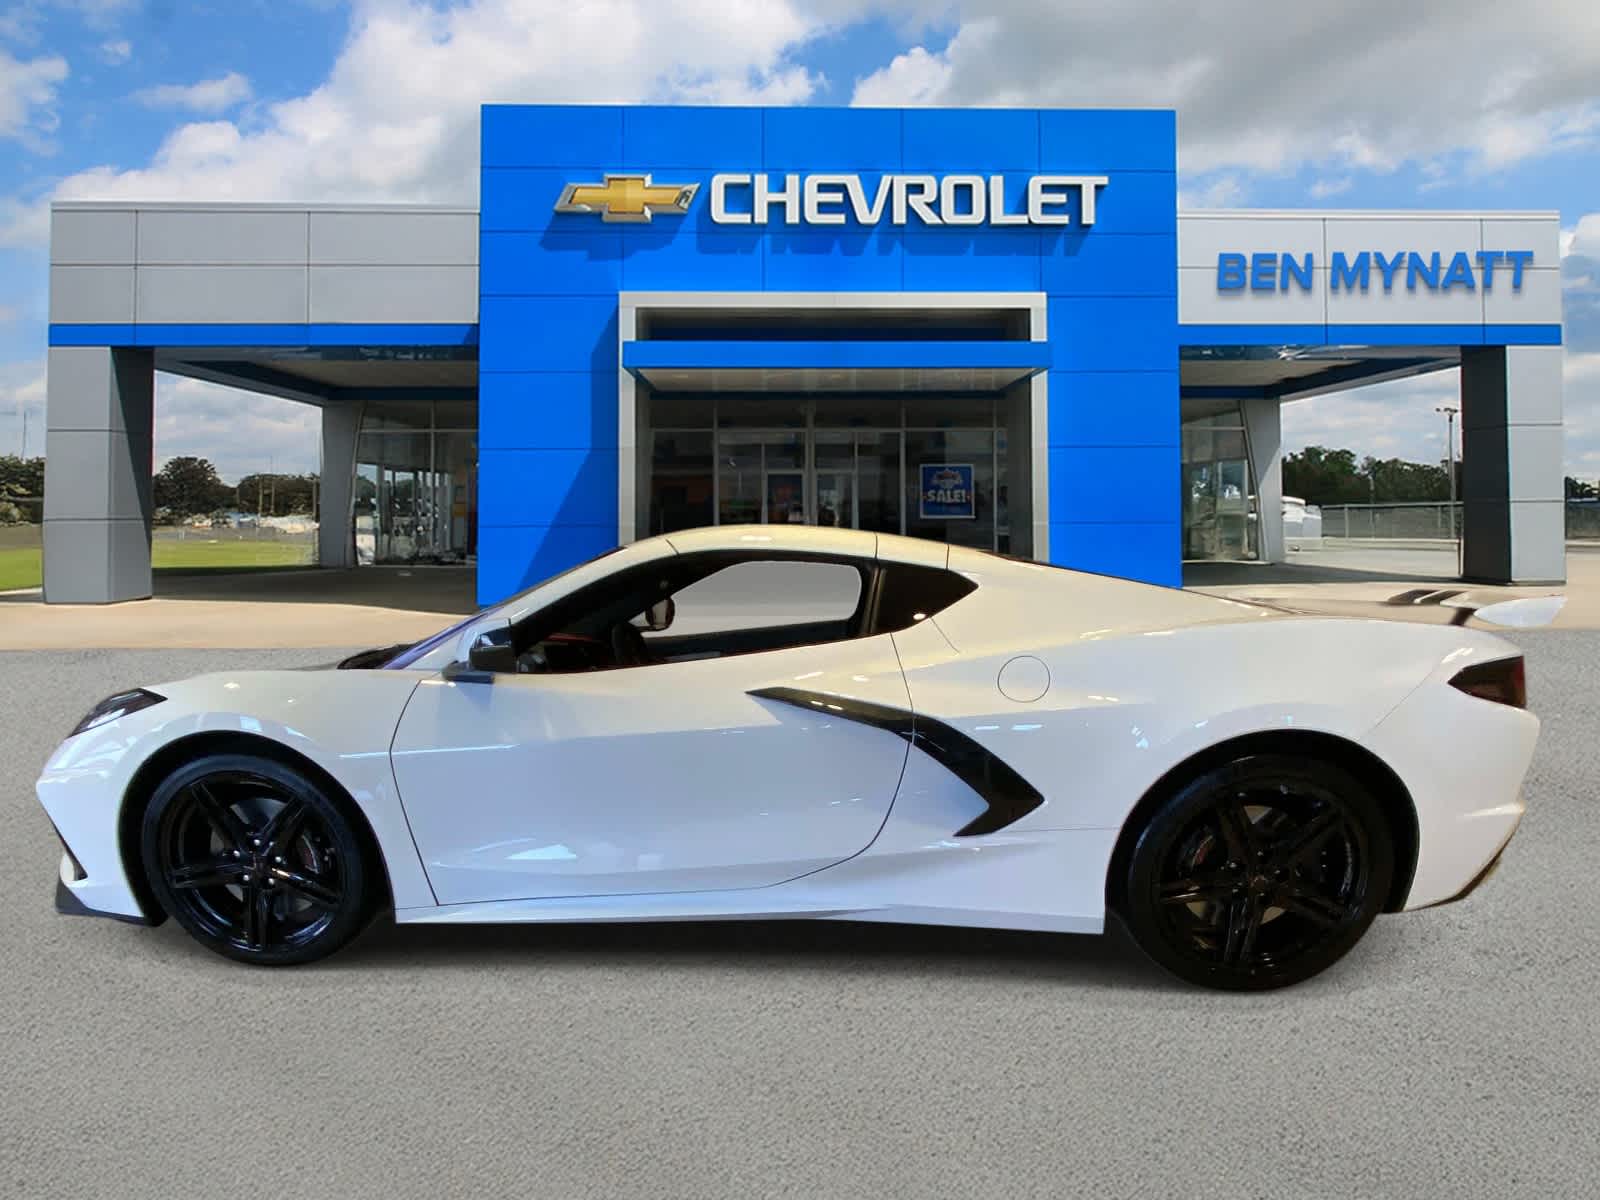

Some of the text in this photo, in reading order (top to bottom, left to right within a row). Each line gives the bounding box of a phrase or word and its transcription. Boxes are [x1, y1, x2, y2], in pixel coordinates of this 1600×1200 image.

[710, 174, 1109, 225] CHEVROLET
[1217, 251, 1534, 291] BEN MYNATT
